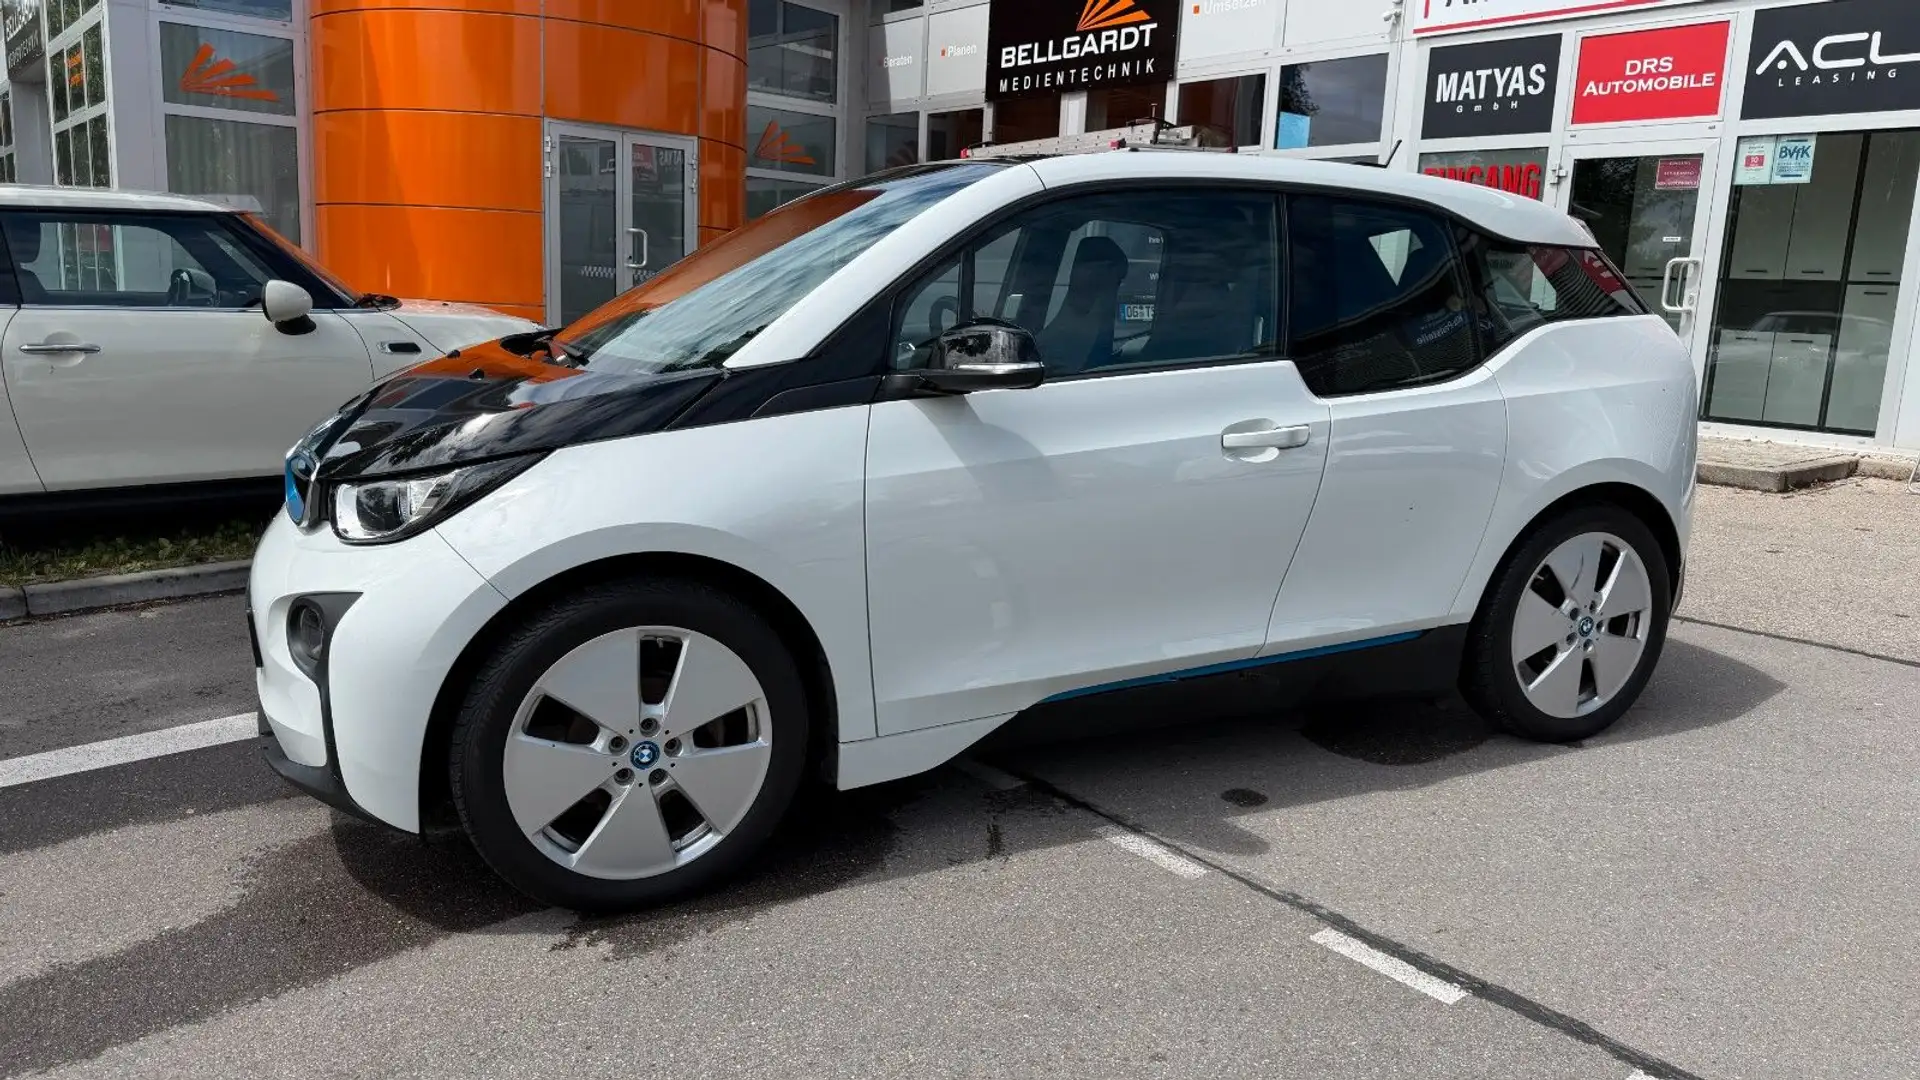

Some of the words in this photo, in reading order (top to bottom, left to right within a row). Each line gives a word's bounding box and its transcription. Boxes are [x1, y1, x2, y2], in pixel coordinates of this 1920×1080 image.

[947, 44, 977, 57] Planen
[1000, 23, 1158, 69] BELLGARDT
[1755, 31, 1920, 75] ACL
[999, 57, 1155, 93] MEDIENTECHNIK
[1435, 63, 1547, 103] MATYAS
[1625, 56, 1674, 76] DRS
[1778, 68, 1897, 87] LEASING
[1582, 72, 1716, 97] AUTOMOBILE
[1424, 161, 1541, 200] GANG
